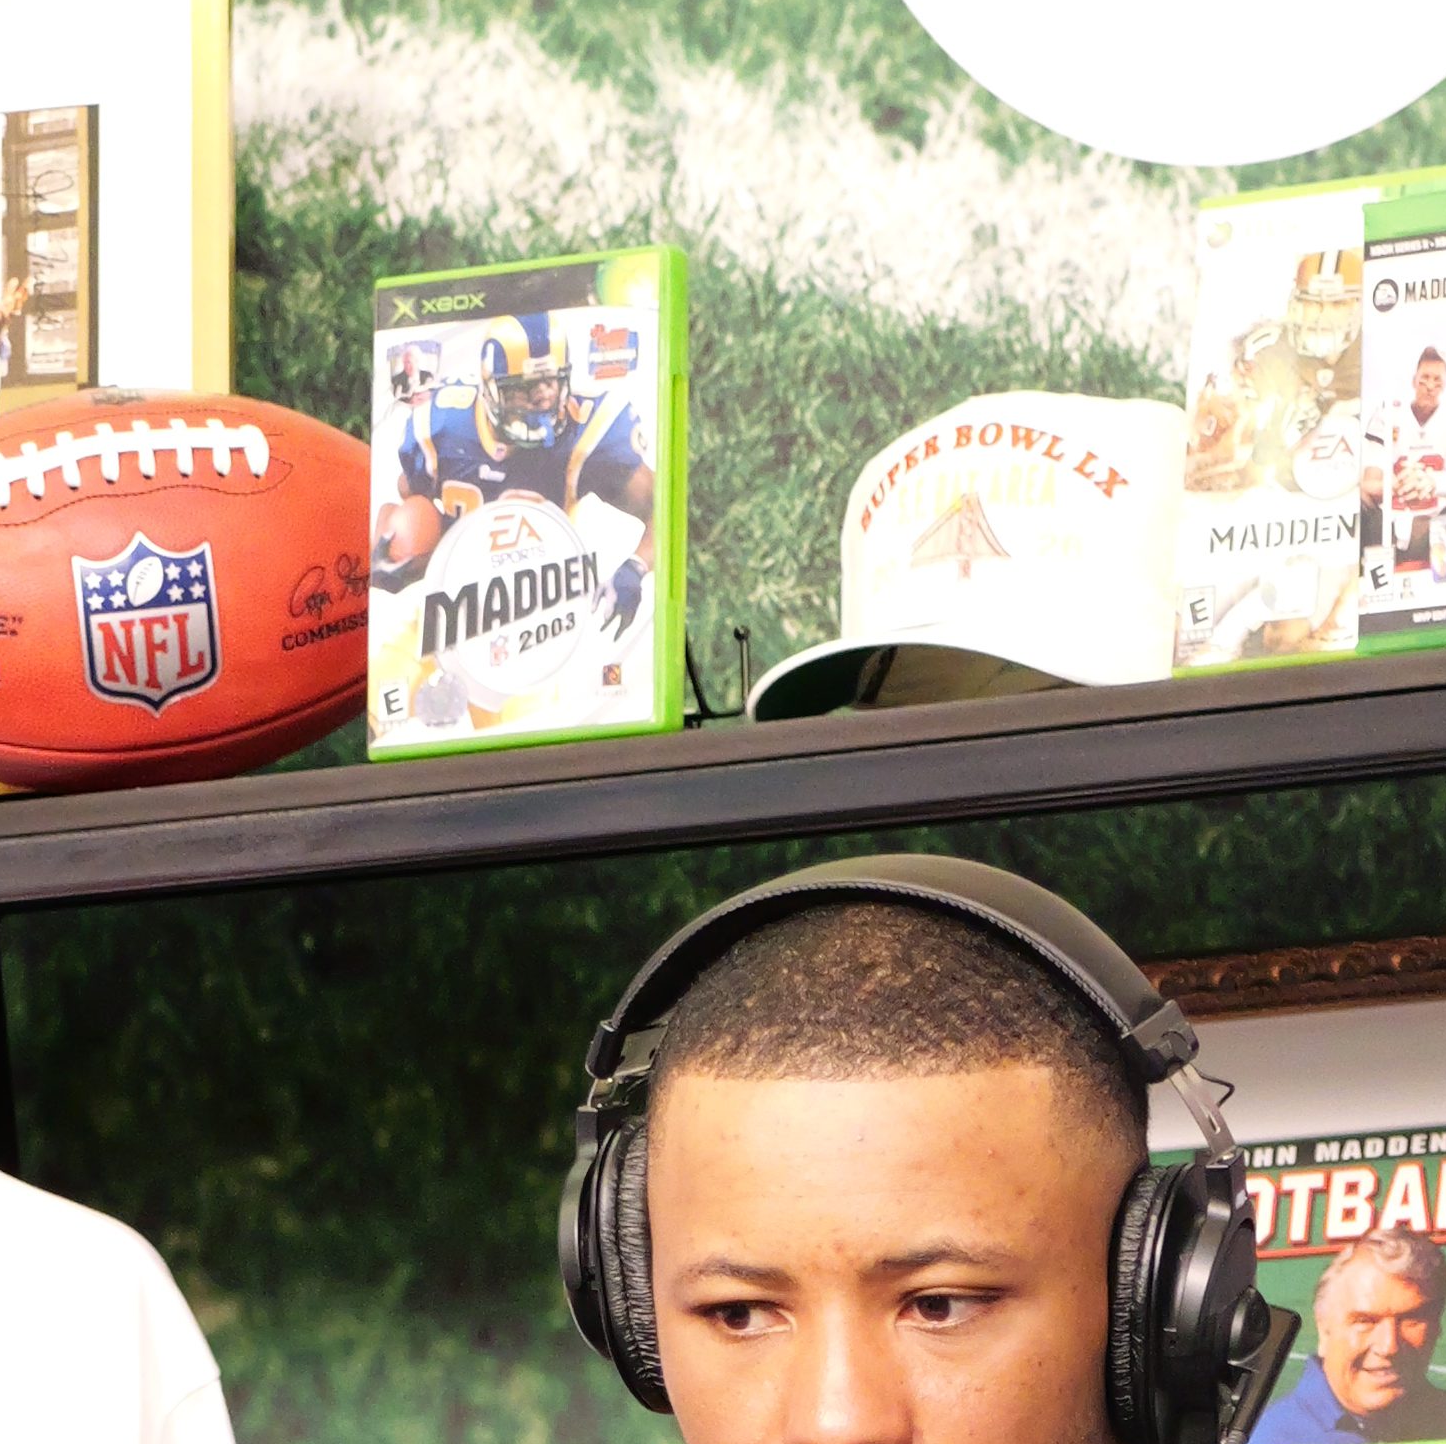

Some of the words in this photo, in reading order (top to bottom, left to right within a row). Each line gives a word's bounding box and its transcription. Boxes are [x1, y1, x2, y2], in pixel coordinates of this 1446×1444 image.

[421, 292, 486, 315] XBOX
[953, 422, 1065, 462] BOWL
[1072, 450, 1129, 499] LX
[487, 513, 544, 552] EA
[1209, 511, 1359, 554] MADDEN
[1369, 564, 1389, 590] E
[420, 551, 600, 658] MADDEN
[1189, 597, 1209, 626] E
[97, 611, 206, 690] NFL
[518, 611, 577, 655] 2003
[384, 687, 405, 716] E
[1244, 1144, 1298, 1169] HN
